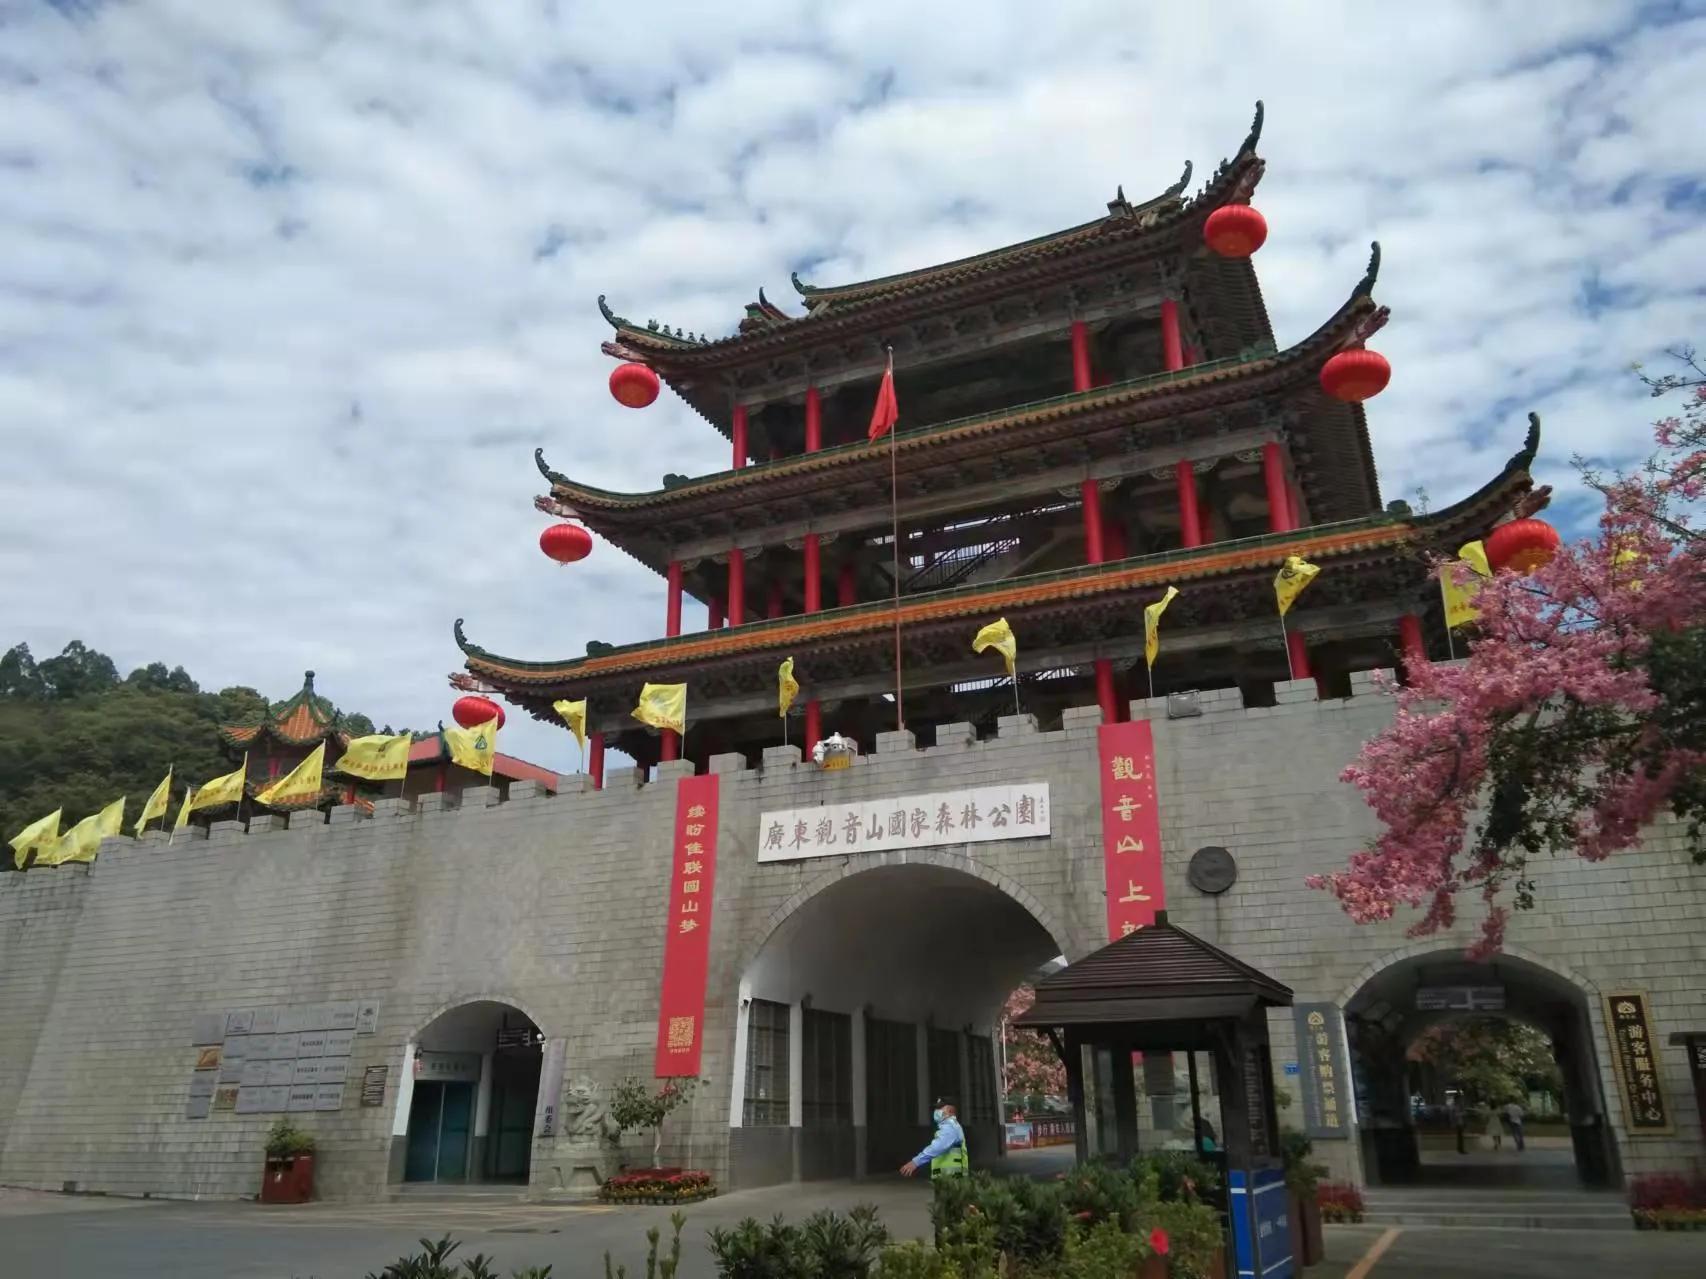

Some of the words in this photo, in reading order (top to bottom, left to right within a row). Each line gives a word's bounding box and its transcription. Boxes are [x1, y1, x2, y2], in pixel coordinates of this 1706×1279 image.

[763, 794, 1036, 851] 廣東觀音山國家森林公園
